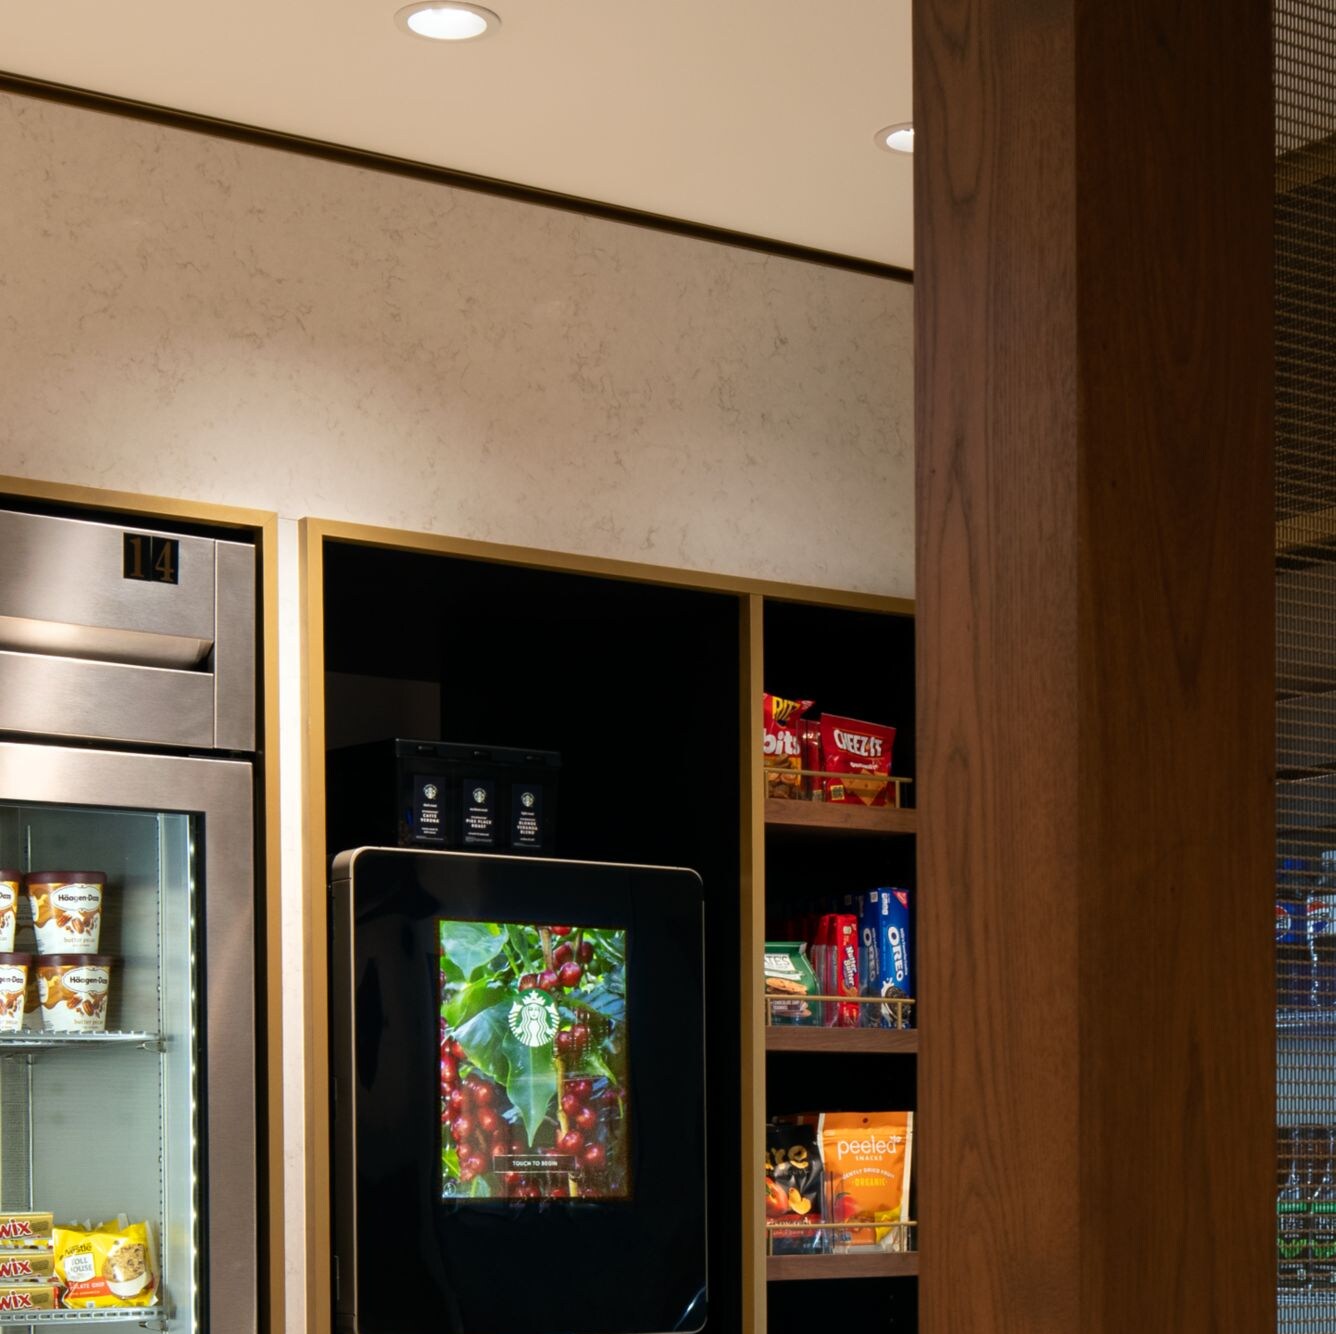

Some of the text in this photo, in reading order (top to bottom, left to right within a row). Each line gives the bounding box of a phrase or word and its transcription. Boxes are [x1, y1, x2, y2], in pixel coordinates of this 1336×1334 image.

[128, 537, 175, 582] 14
[888, 926, 904, 982] OREO
[838, 1135, 897, 1160] peeled
